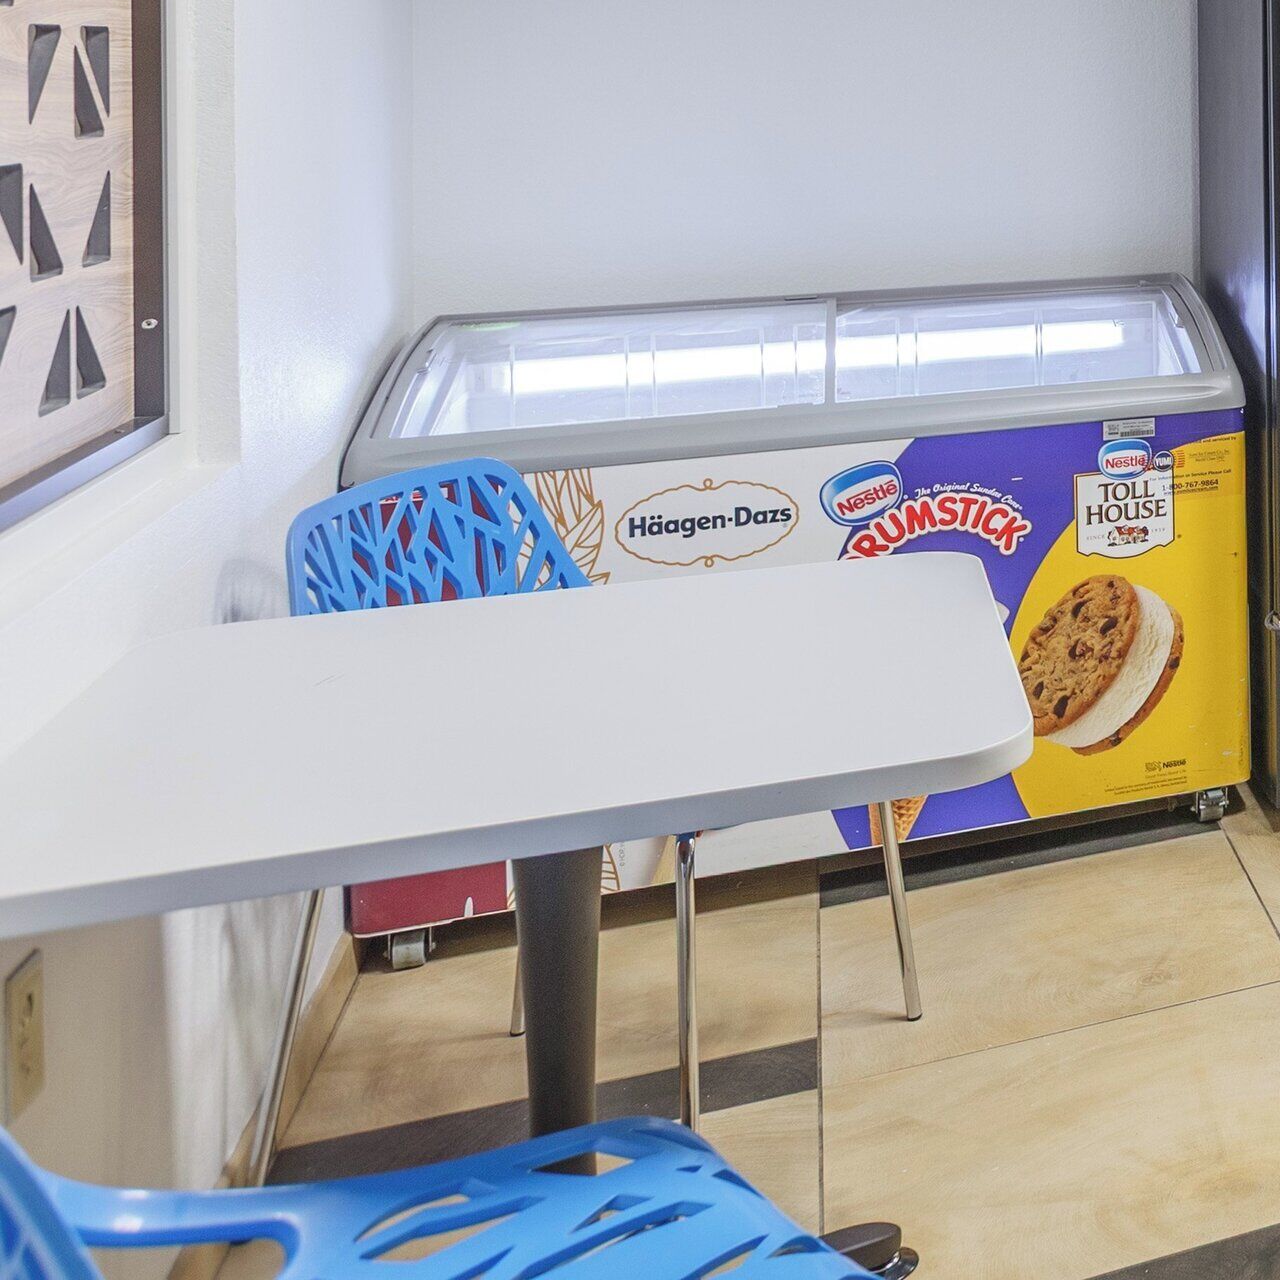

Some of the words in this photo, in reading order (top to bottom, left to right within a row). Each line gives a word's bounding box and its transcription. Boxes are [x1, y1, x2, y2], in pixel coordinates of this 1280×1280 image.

[1105, 454, 1147, 469] Nestlé
[836, 478, 899, 518] Nestlé
[915, 488, 931, 499] The
[933, 482, 970, 493] Original
[970, 483, 1002, 498] Sundae
[1001, 494, 1020, 510] Cone
[1098, 480, 1156, 503] TOLL
[628, 506, 793, 538] Häagen-Dazs
[1086, 499, 1168, 526] HOUSE
[842, 496, 1028, 559] RUMSTICK
